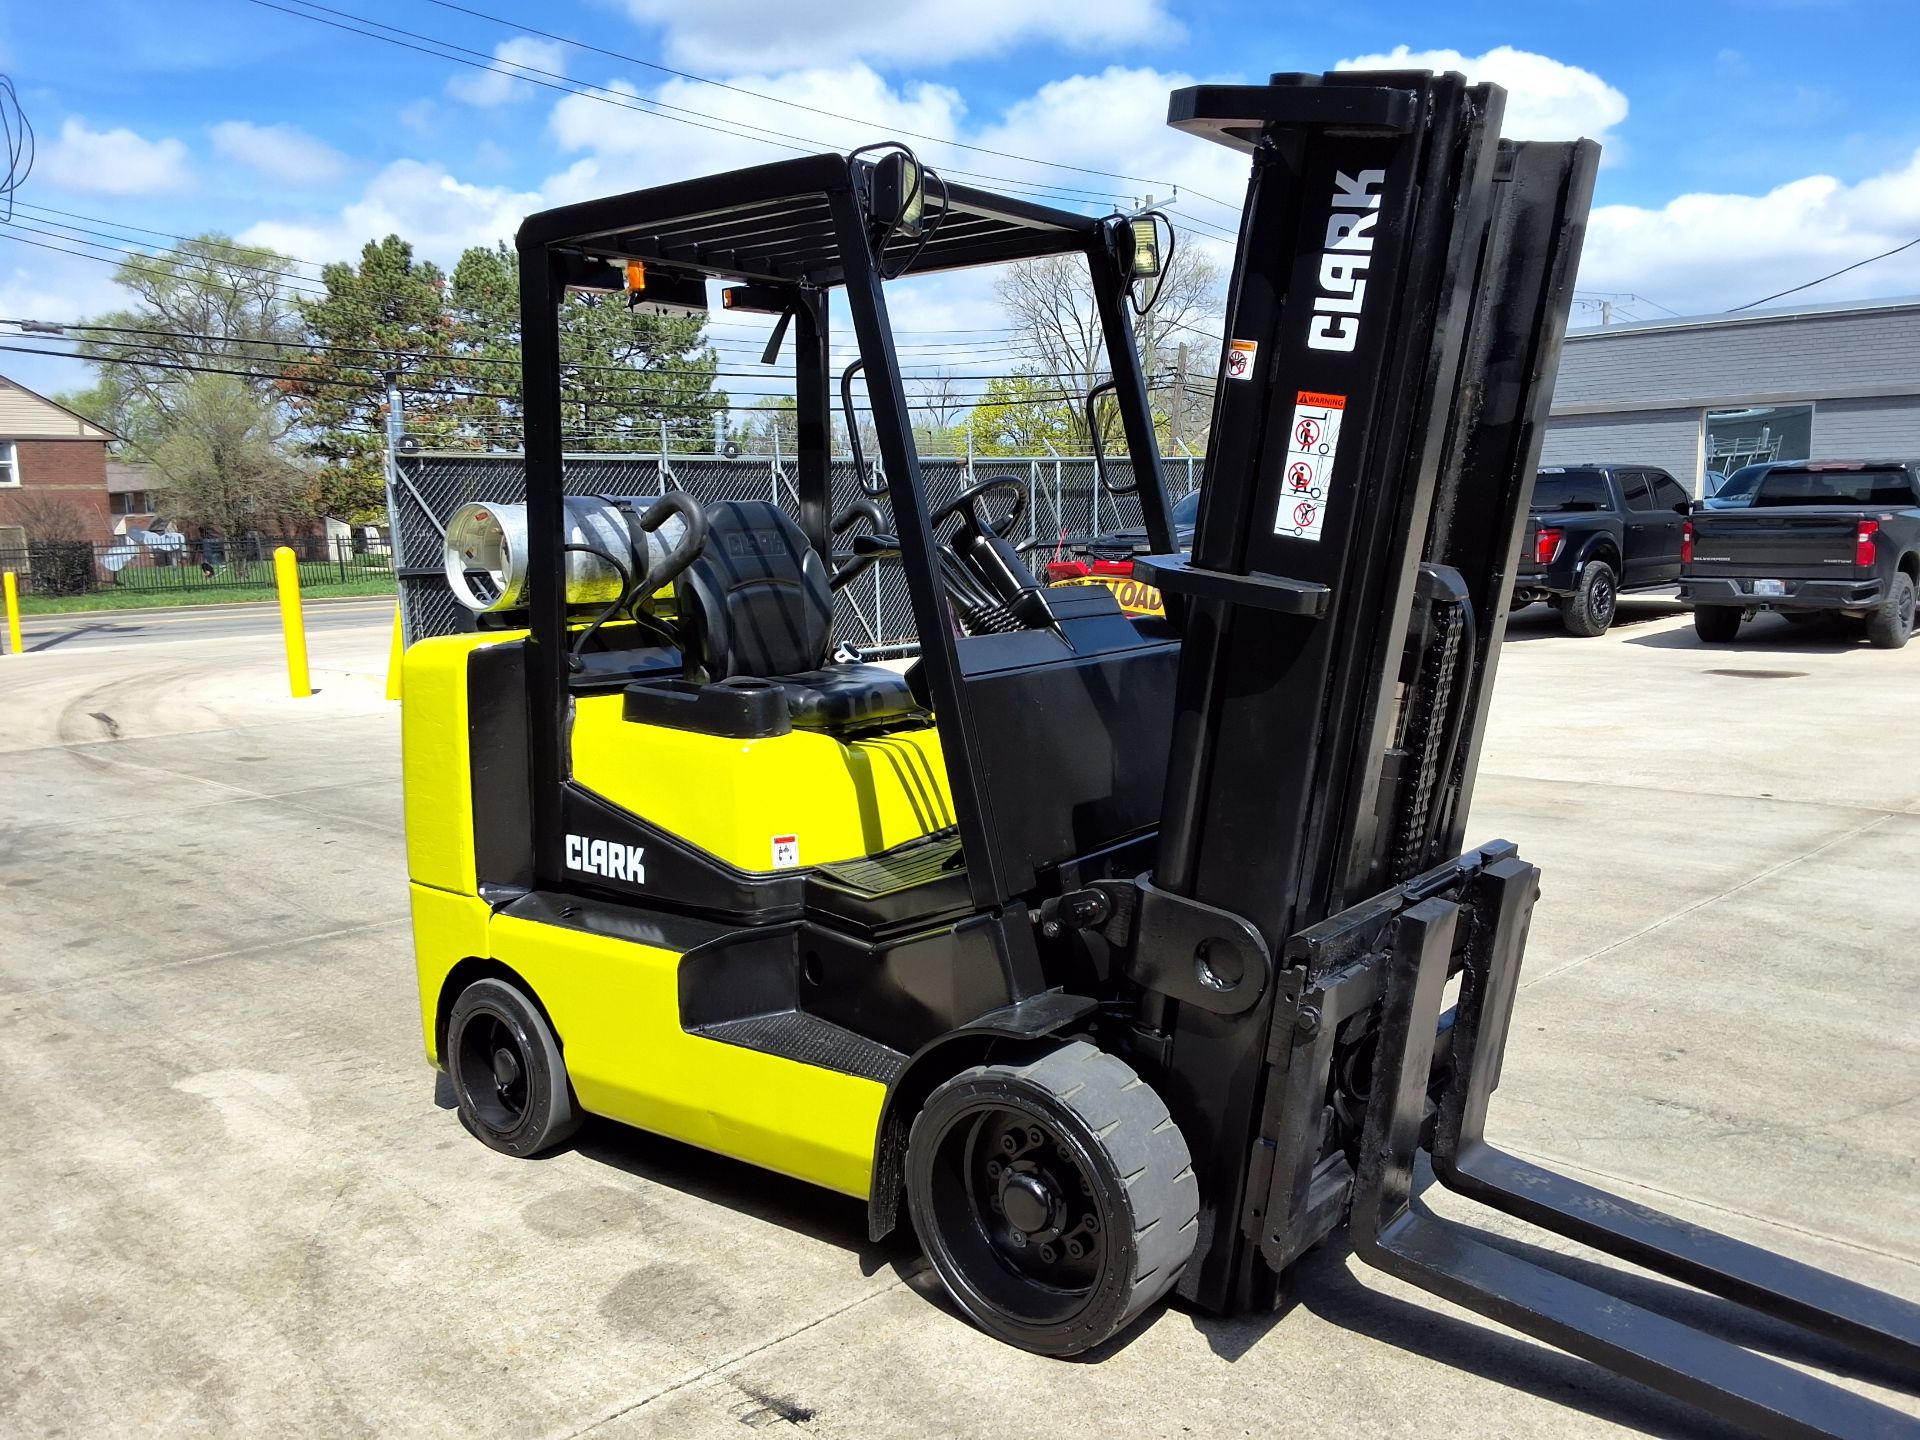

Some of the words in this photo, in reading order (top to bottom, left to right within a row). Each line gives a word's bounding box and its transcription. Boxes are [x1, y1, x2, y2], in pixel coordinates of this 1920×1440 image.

[1307, 169, 1386, 352] CLARK
[1308, 395, 1344, 407] WARNING
[565, 834, 645, 885] CLARK
